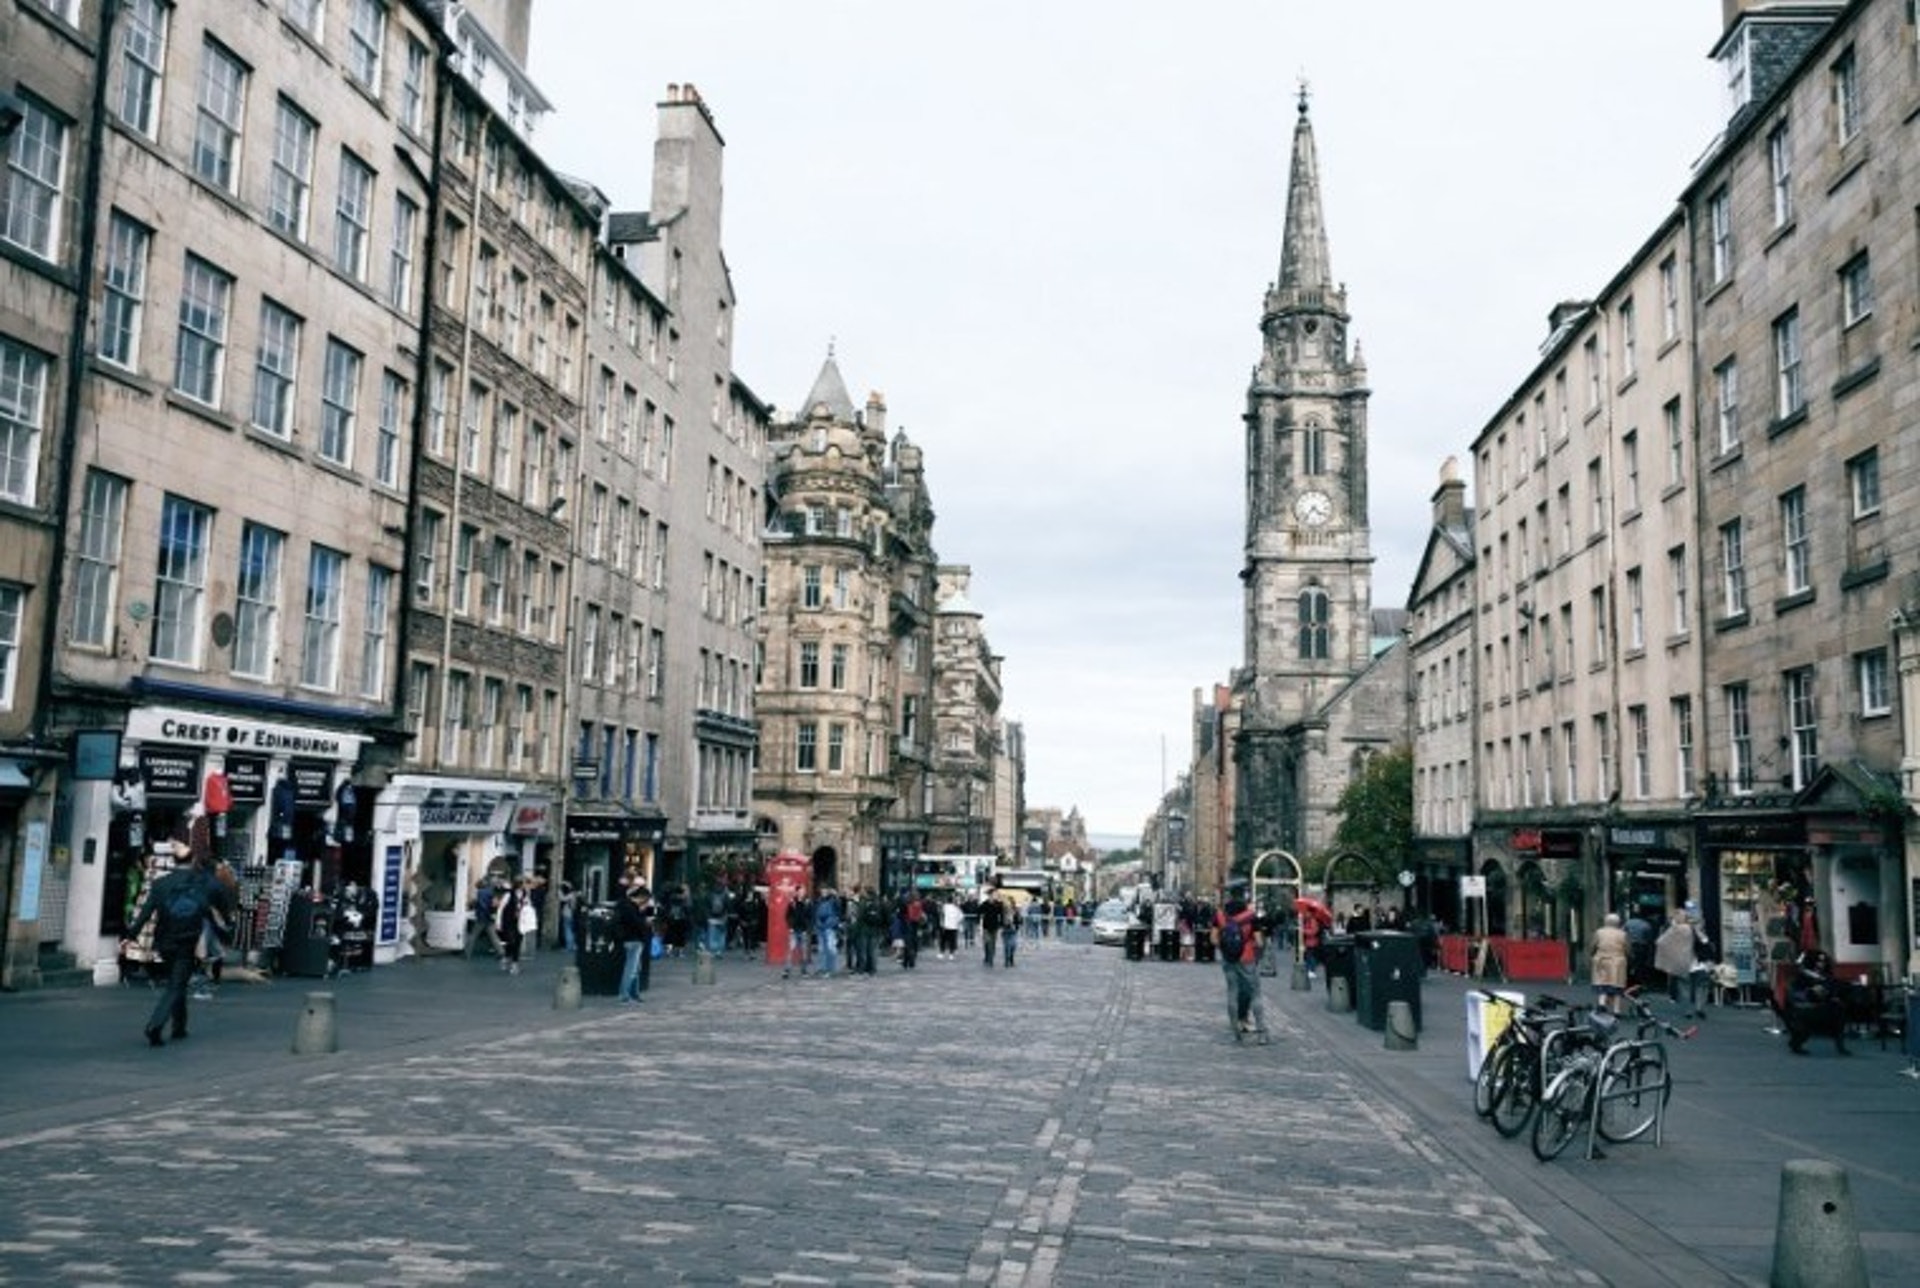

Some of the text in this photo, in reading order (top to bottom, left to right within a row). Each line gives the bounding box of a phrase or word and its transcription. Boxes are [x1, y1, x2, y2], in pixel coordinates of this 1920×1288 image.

[162, 719, 339, 752] CREST OF EDINBURGH
